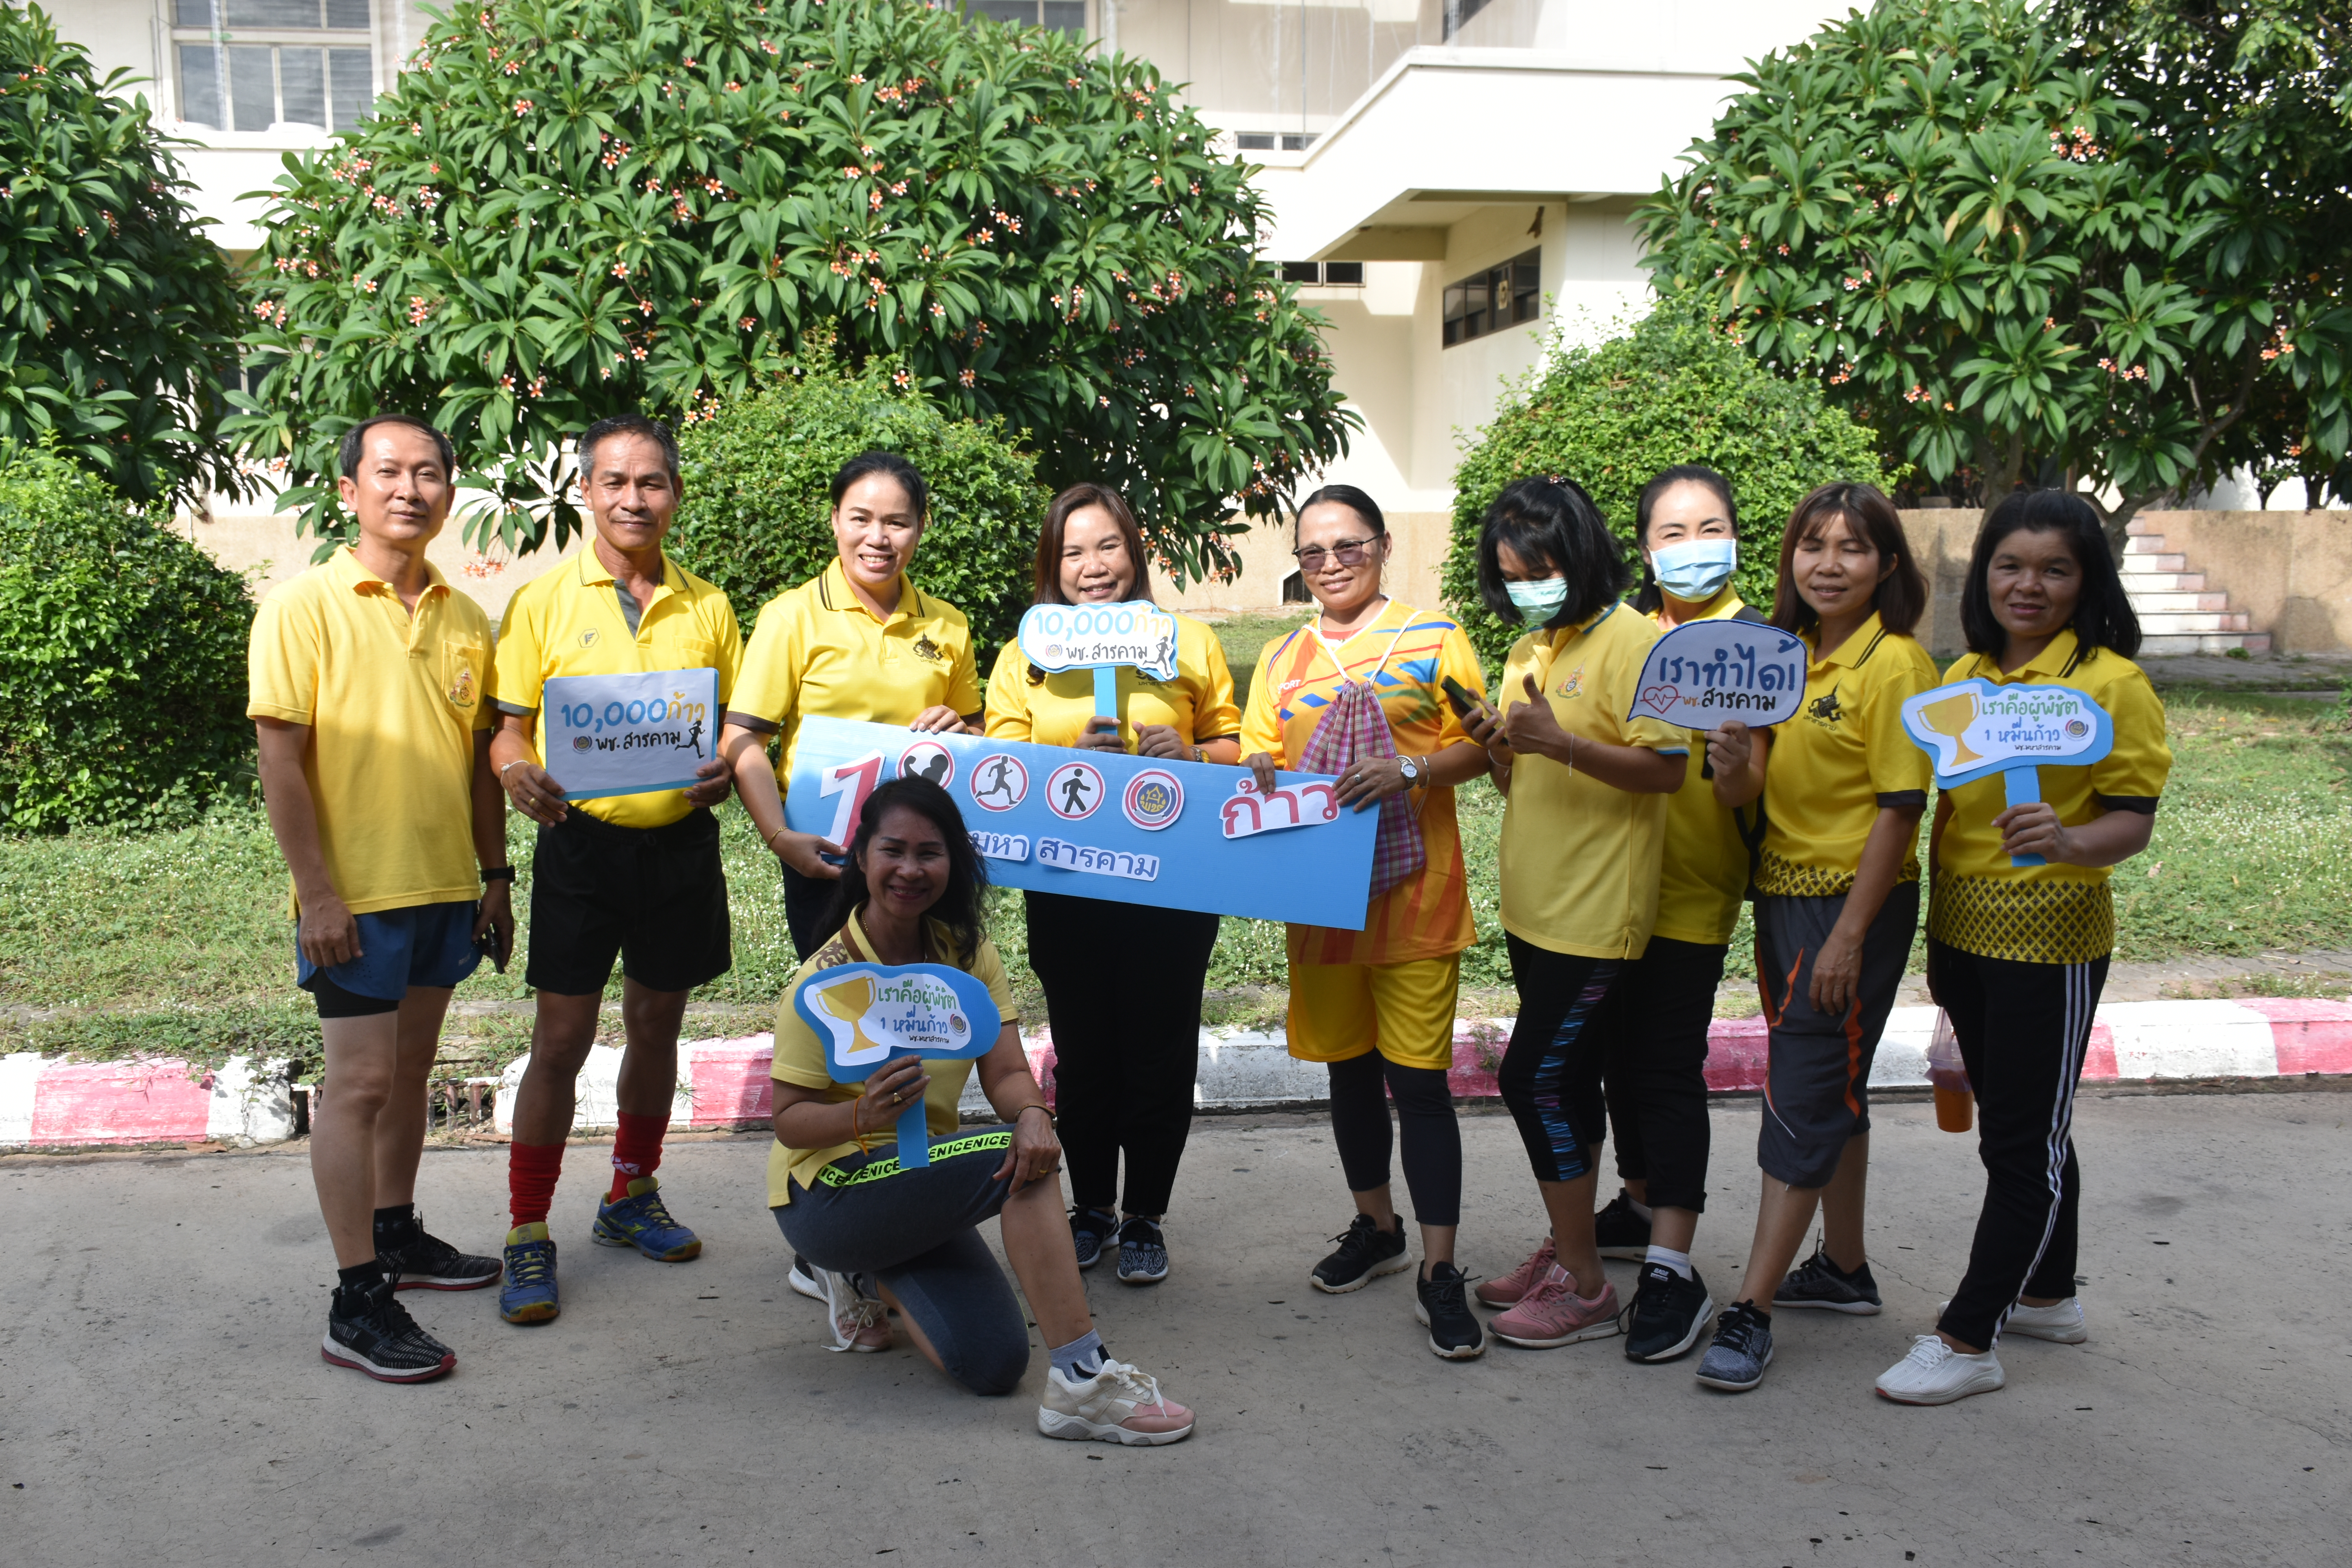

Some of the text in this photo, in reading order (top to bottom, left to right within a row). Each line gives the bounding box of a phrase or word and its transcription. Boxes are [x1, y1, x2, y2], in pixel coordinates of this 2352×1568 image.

[1982, 693, 2078, 721] เราคือผู้พิชิต
[1985, 729, 1990, 740] 1
[1998, 717, 2060, 743] หมื่นก้าว
[1222, 780, 1338, 835] ก้าว
[1040, 838, 1158, 878] สารคาม
[878, 979, 956, 1011] เราคือผู้พิชิต
[880, 1017, 886, 1029] 1
[893, 1005, 948, 1034] หมื่นก้าว
